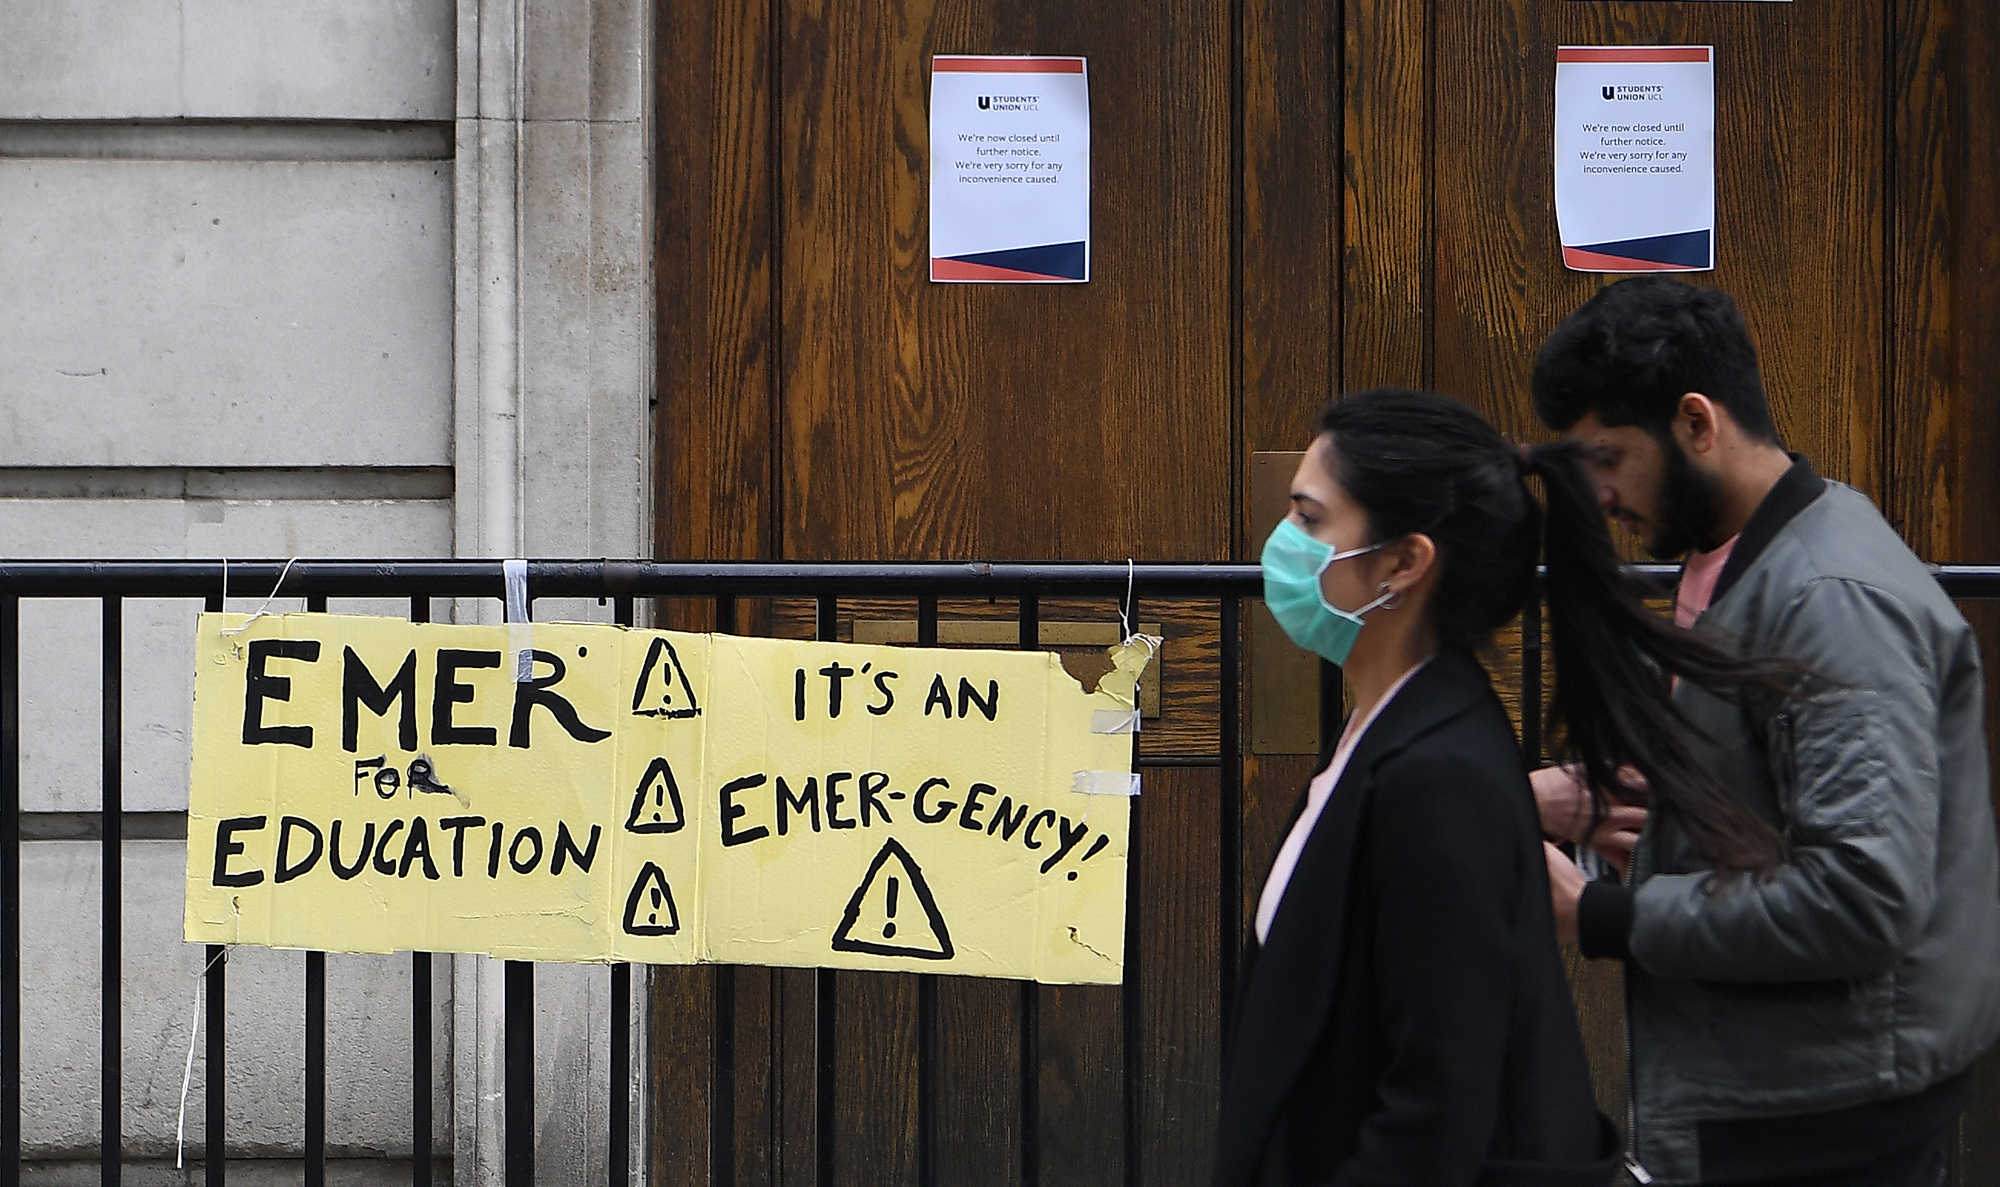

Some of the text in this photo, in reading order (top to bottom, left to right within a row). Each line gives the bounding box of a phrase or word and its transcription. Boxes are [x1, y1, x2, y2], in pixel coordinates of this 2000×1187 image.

[1582, 124, 1609, 132] We're
[1633, 124, 1661, 132] closed
[1664, 123, 1685, 132] until
[958, 134, 984, 142] We're
[1008, 134, 1037, 142] closed
[1040, 134, 1060, 142] until
[1601, 137, 1666, 145] further notice.
[976, 147, 1041, 156] further notice.
[1579, 151, 1687, 162] We're very sorry for any
[955, 161, 1063, 172] We're very sorry for any
[1583, 164, 1683, 173] inconvenience caused.
[959, 174, 1059, 183] inconvenience caused.
[794, 661, 999, 721] IT'S AN
[354, 756, 453, 799] FOR
[720, 771, 1110, 882] EMER-GENCY!
[212, 816, 601, 887] EDUCATION
